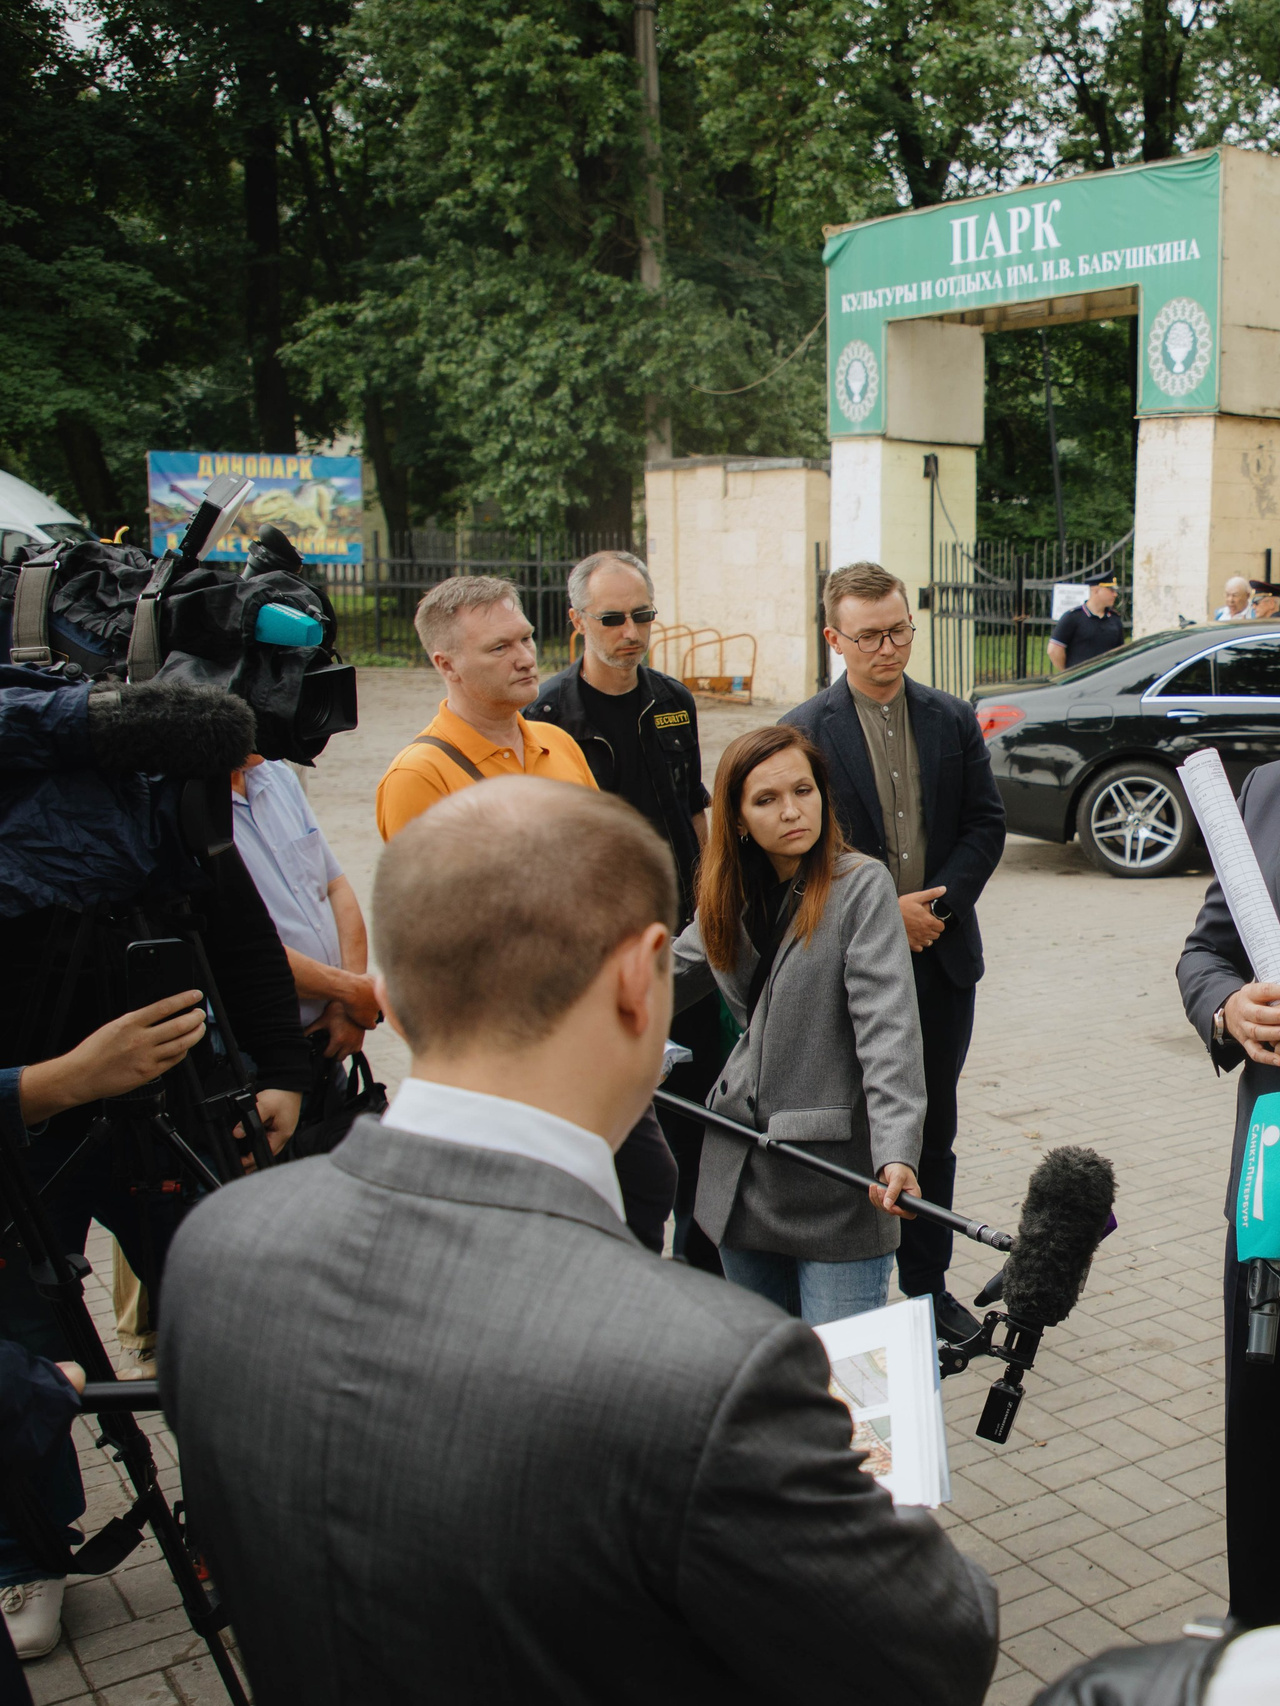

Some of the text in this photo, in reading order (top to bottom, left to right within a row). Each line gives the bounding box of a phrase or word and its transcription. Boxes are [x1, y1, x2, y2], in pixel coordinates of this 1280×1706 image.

[949, 199, 1062, 265] ПАРК
[841, 238, 1201, 313] КУЛЬТУРЫ И ОТДЫХА ИМ. И.В. БАБУШКИНА
[197, 455, 314, 480] ДИНОПАРК
[655, 713, 688, 726] SECURITY
[1242, 1123, 1260, 1228] САНКТ-ПЕТЕРБУРГ
